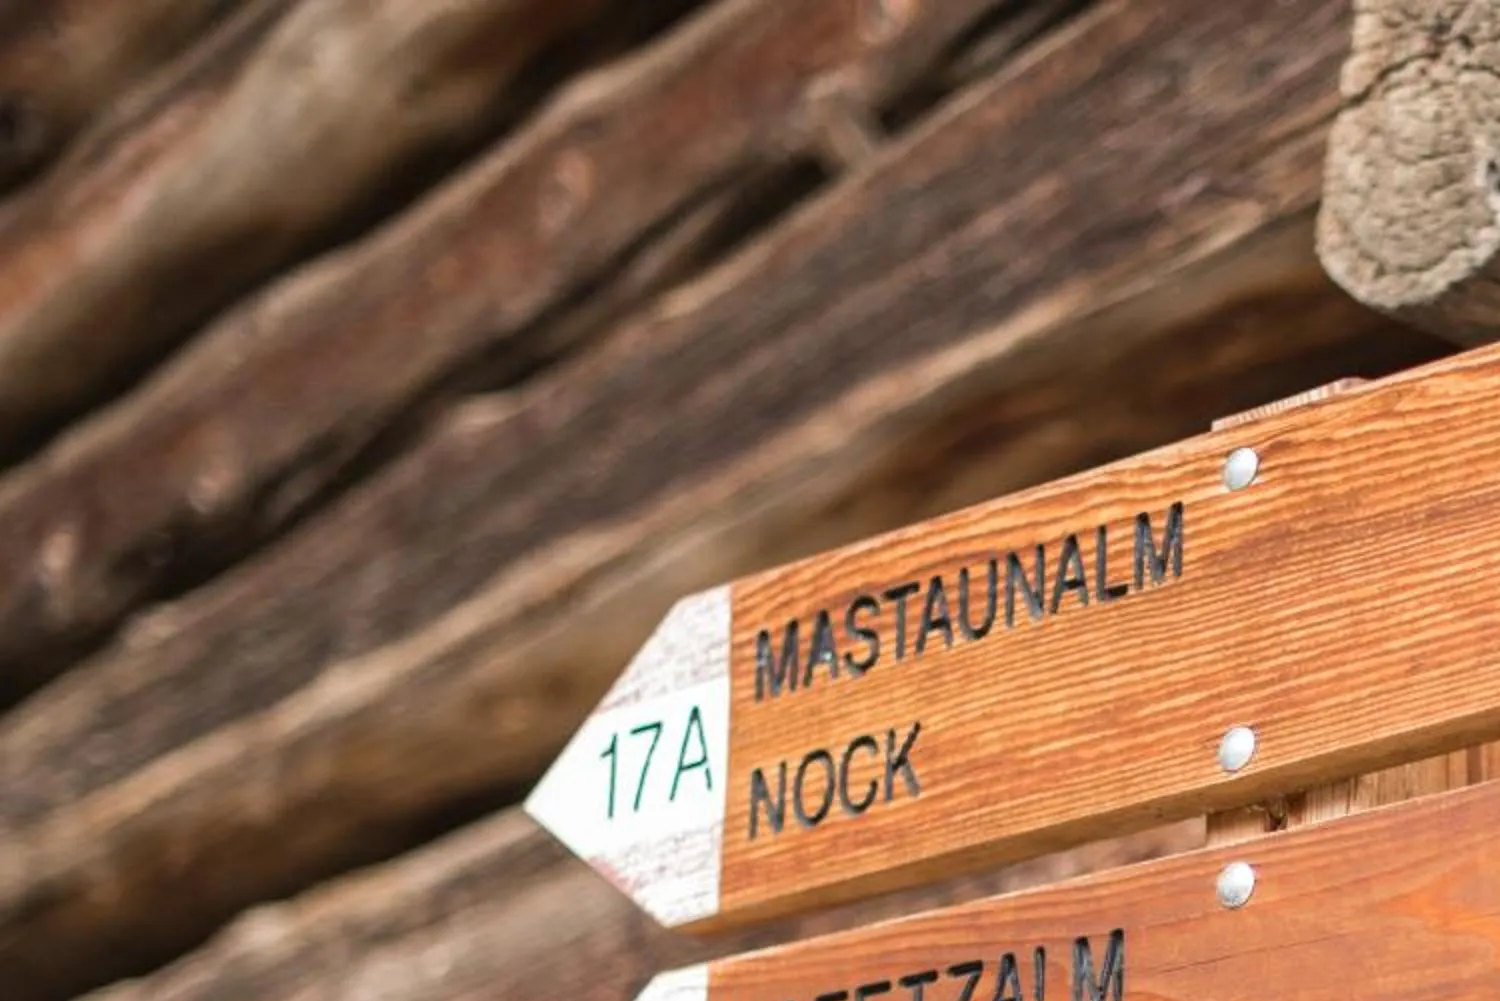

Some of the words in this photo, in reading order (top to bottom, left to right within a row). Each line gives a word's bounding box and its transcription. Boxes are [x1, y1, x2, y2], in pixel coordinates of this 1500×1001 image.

[754, 501, 1184, 703] MASTAUNALM
[600, 704, 713, 820] 17A
[748, 721, 922, 840] NOCK
